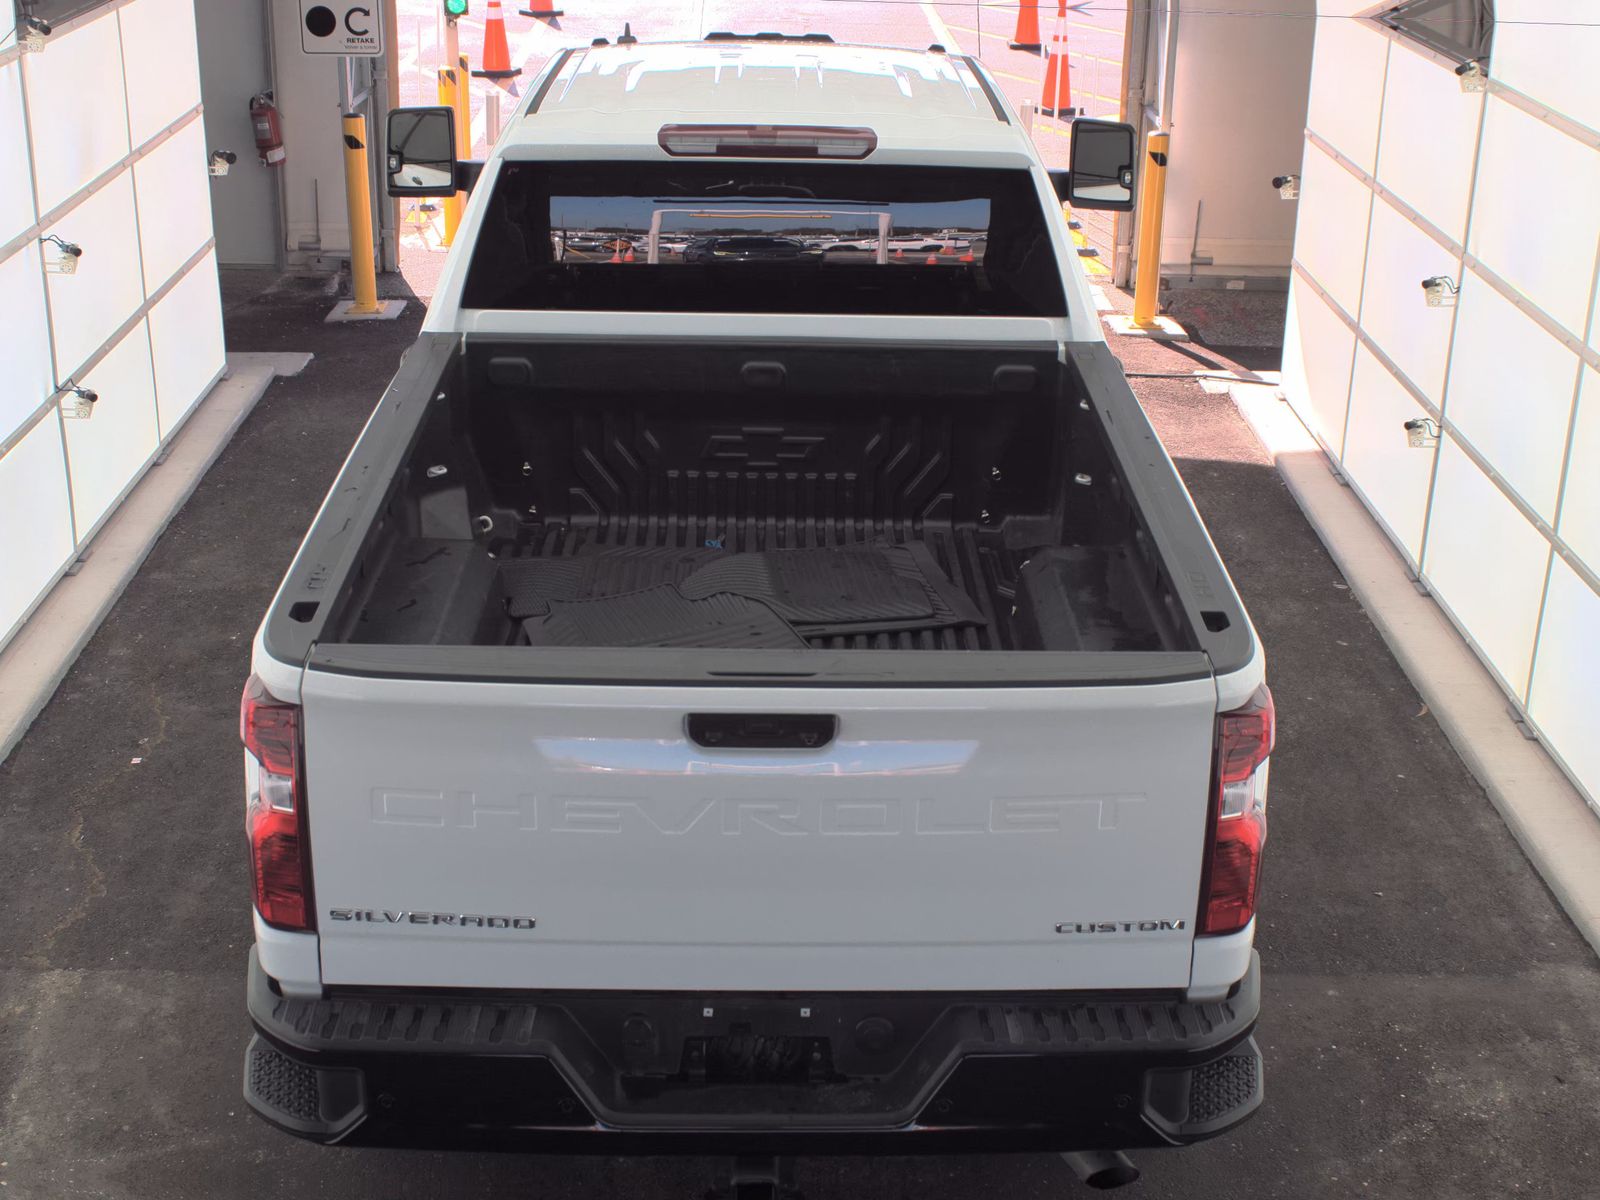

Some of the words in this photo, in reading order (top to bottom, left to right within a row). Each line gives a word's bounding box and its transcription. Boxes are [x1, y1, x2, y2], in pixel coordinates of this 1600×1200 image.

[371, 787, 1147, 836] CHEVROLET
[329, 908, 537, 930] SILVERADO
[1055, 919, 1186, 934] CUSTOM
